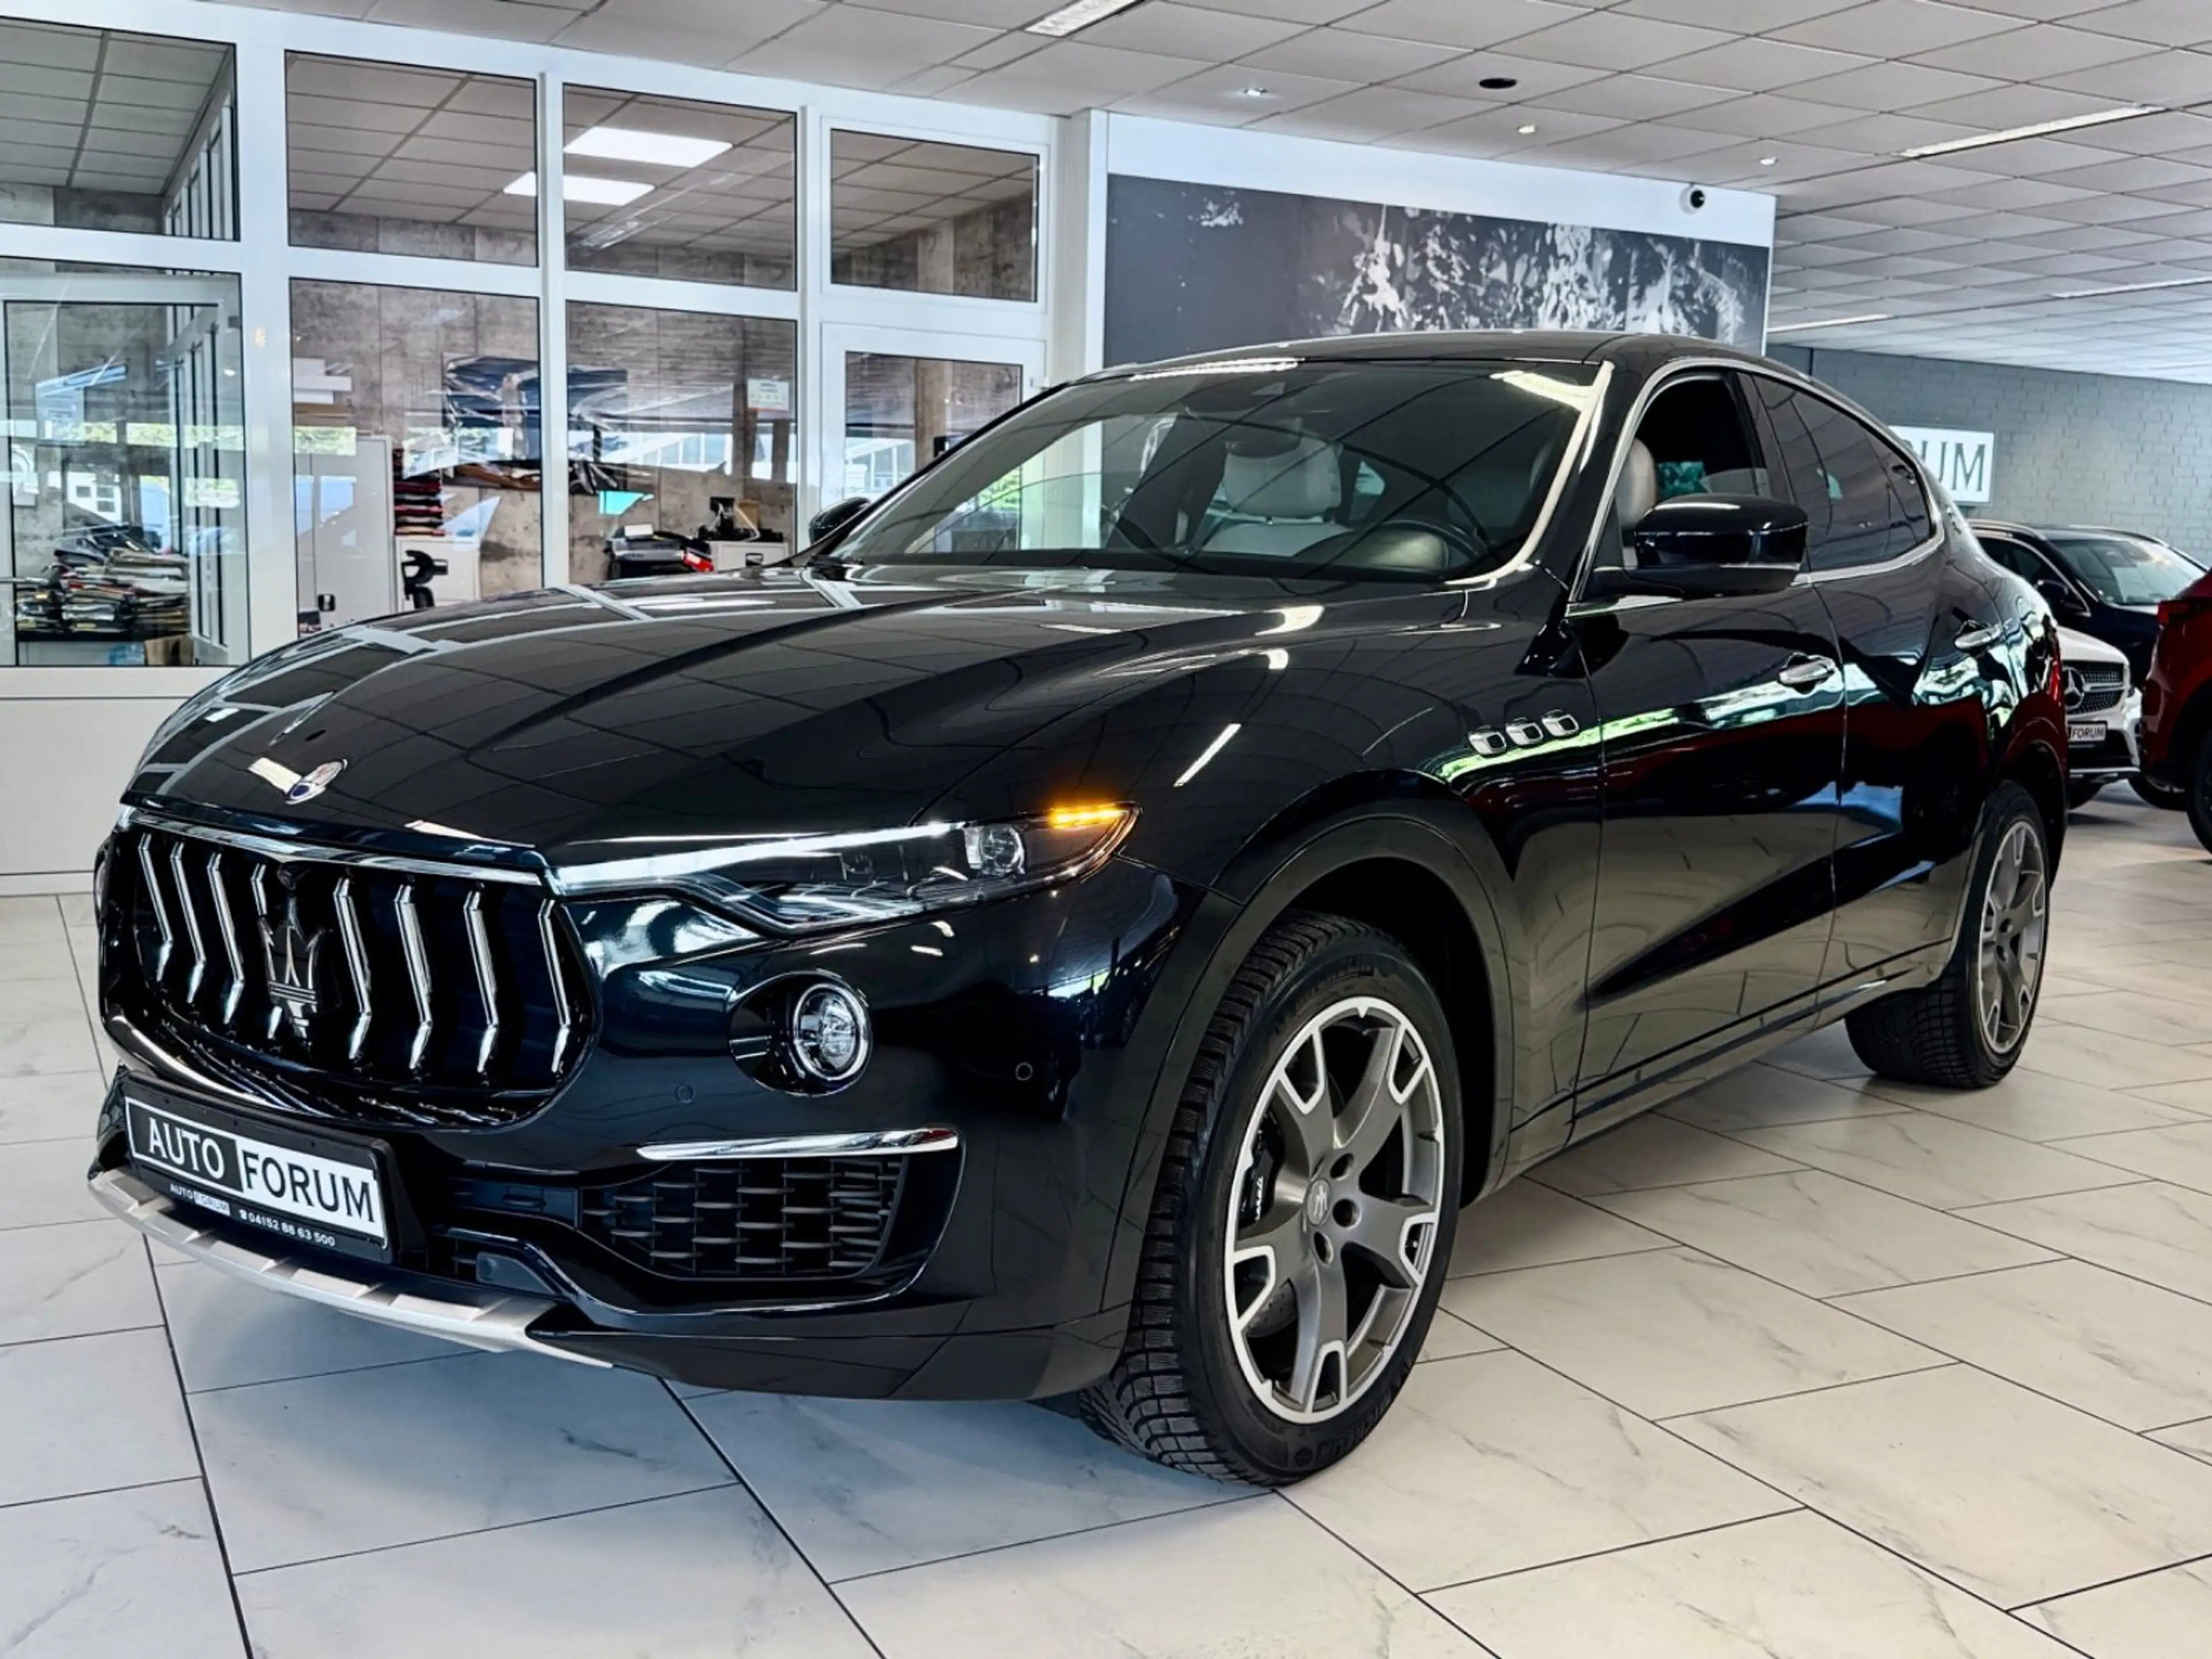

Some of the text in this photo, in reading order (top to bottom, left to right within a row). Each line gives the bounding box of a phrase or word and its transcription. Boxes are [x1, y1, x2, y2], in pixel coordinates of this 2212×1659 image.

[149, 1116, 376, 1222] AUTO FORUM
[169, 1183, 194, 1200] AUTO
[248, 1211, 280, 1231] 04152
[297, 1226, 312, 1241] 63
[313, 1231, 336, 1247] 500
